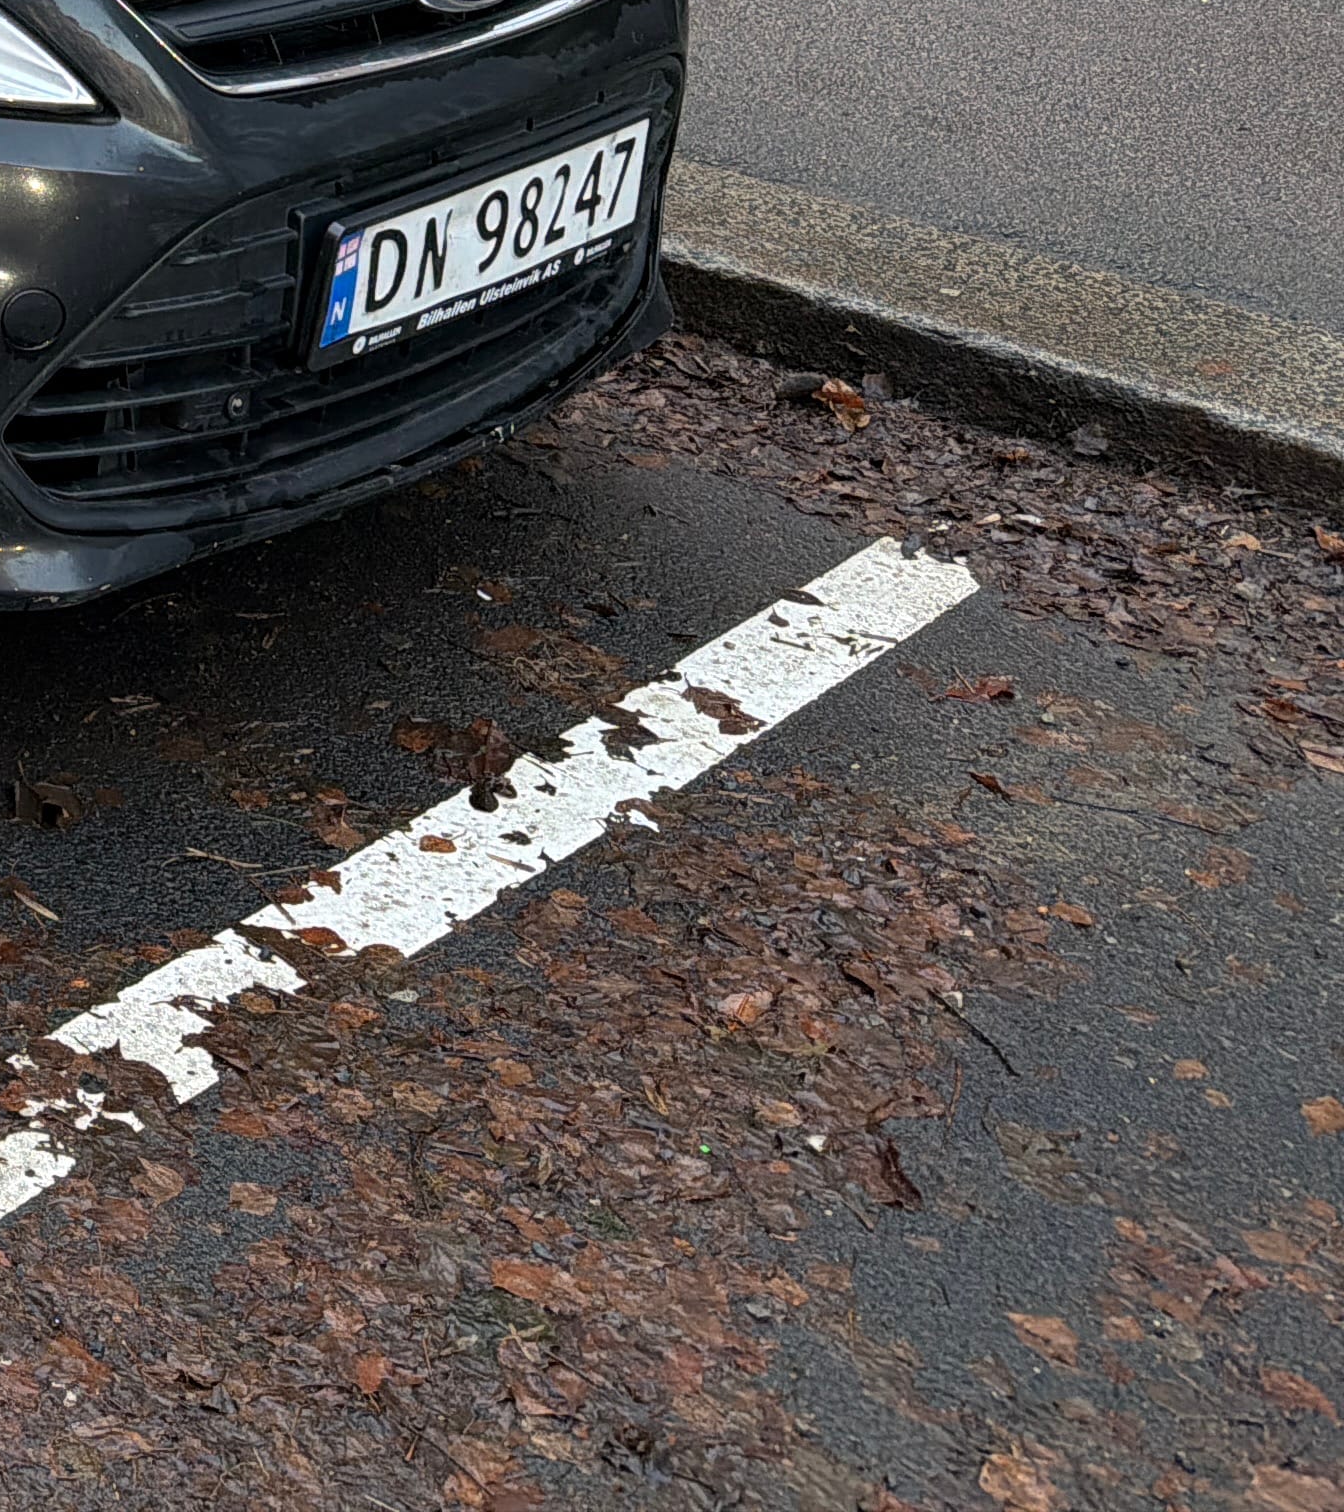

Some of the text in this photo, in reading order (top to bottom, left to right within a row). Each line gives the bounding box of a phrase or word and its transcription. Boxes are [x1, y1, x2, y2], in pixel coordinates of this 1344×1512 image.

[364, 136, 637, 315] DN 98247
[329, 296, 348, 326] N
[416, 259, 562, 330] Bilhallen Ulsteinvik AS
